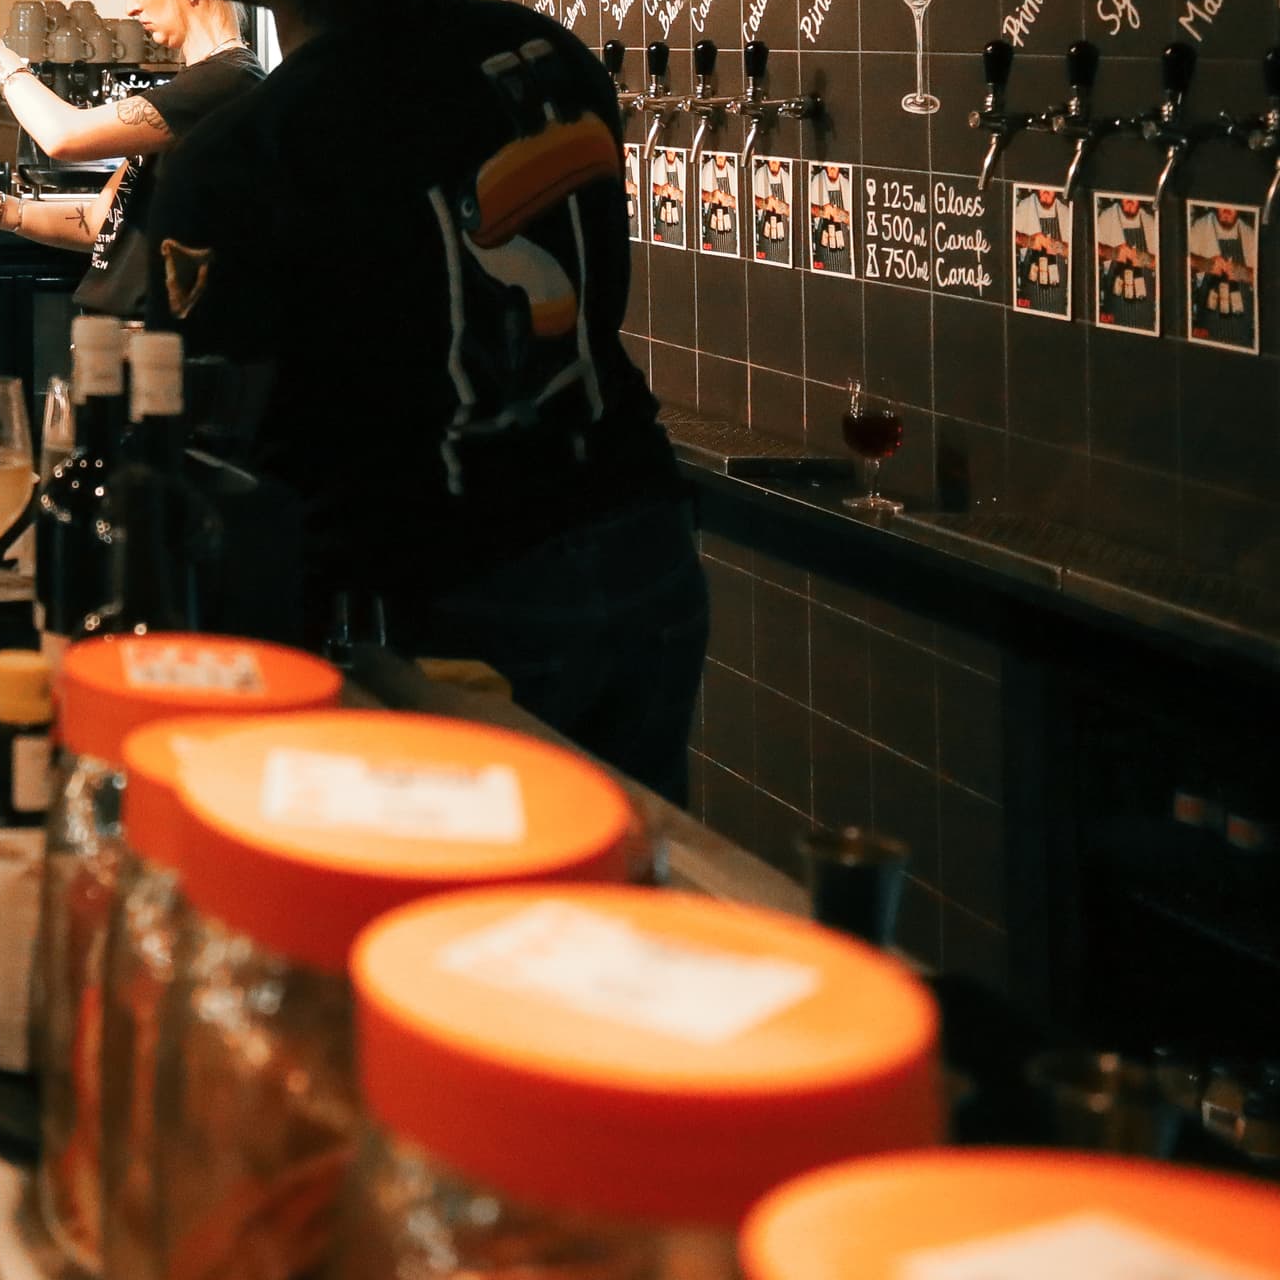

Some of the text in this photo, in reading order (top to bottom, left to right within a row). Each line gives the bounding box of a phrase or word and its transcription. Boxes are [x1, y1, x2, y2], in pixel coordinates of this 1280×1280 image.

[882, 181, 985, 217] 125ml Glass
[881, 214, 991, 263] 500ml Carafe
[881, 247, 992, 297] 750ml Carafe
